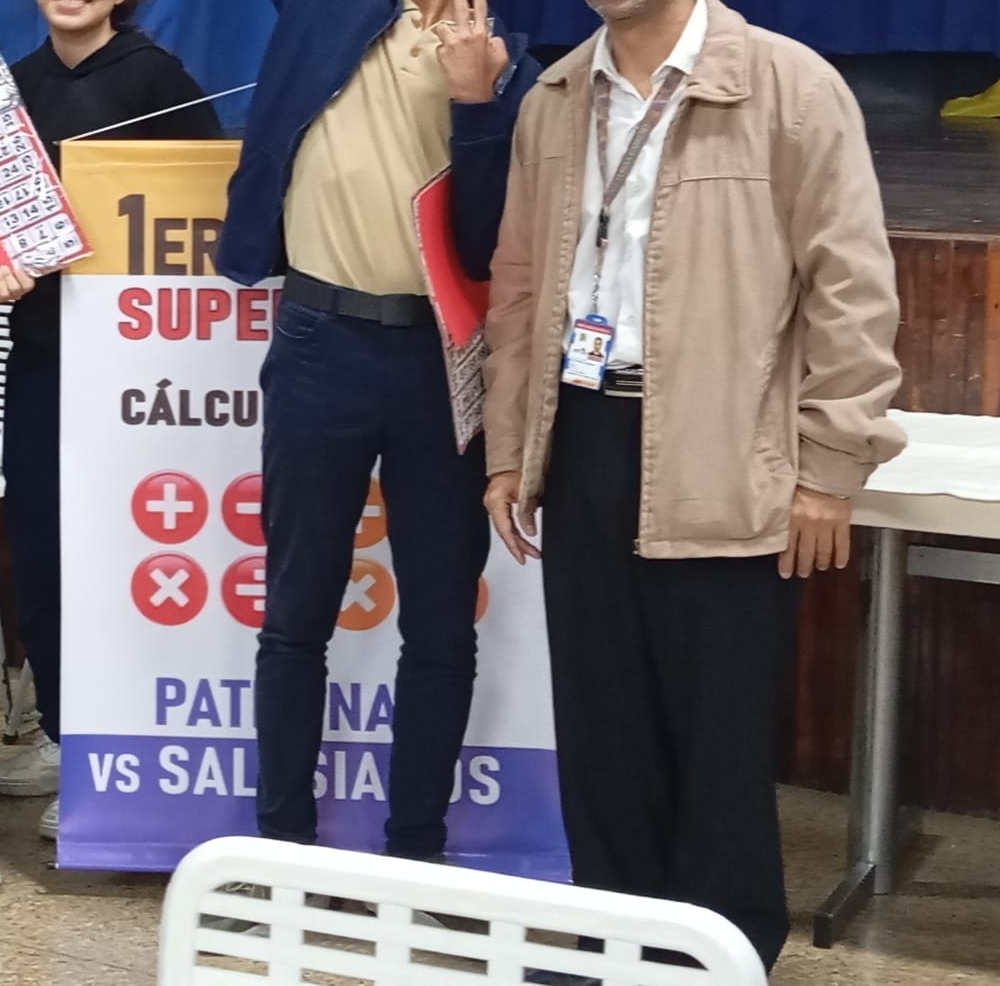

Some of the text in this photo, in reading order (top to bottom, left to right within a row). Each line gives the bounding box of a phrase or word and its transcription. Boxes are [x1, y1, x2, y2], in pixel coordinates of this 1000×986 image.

[2, 164, 19, 178] 24
[22, 204, 39, 218] 14
[117, 287, 283, 341] SUPE
[121, 378, 260, 427] CÁLCU
[88, 753, 141, 794] VS
